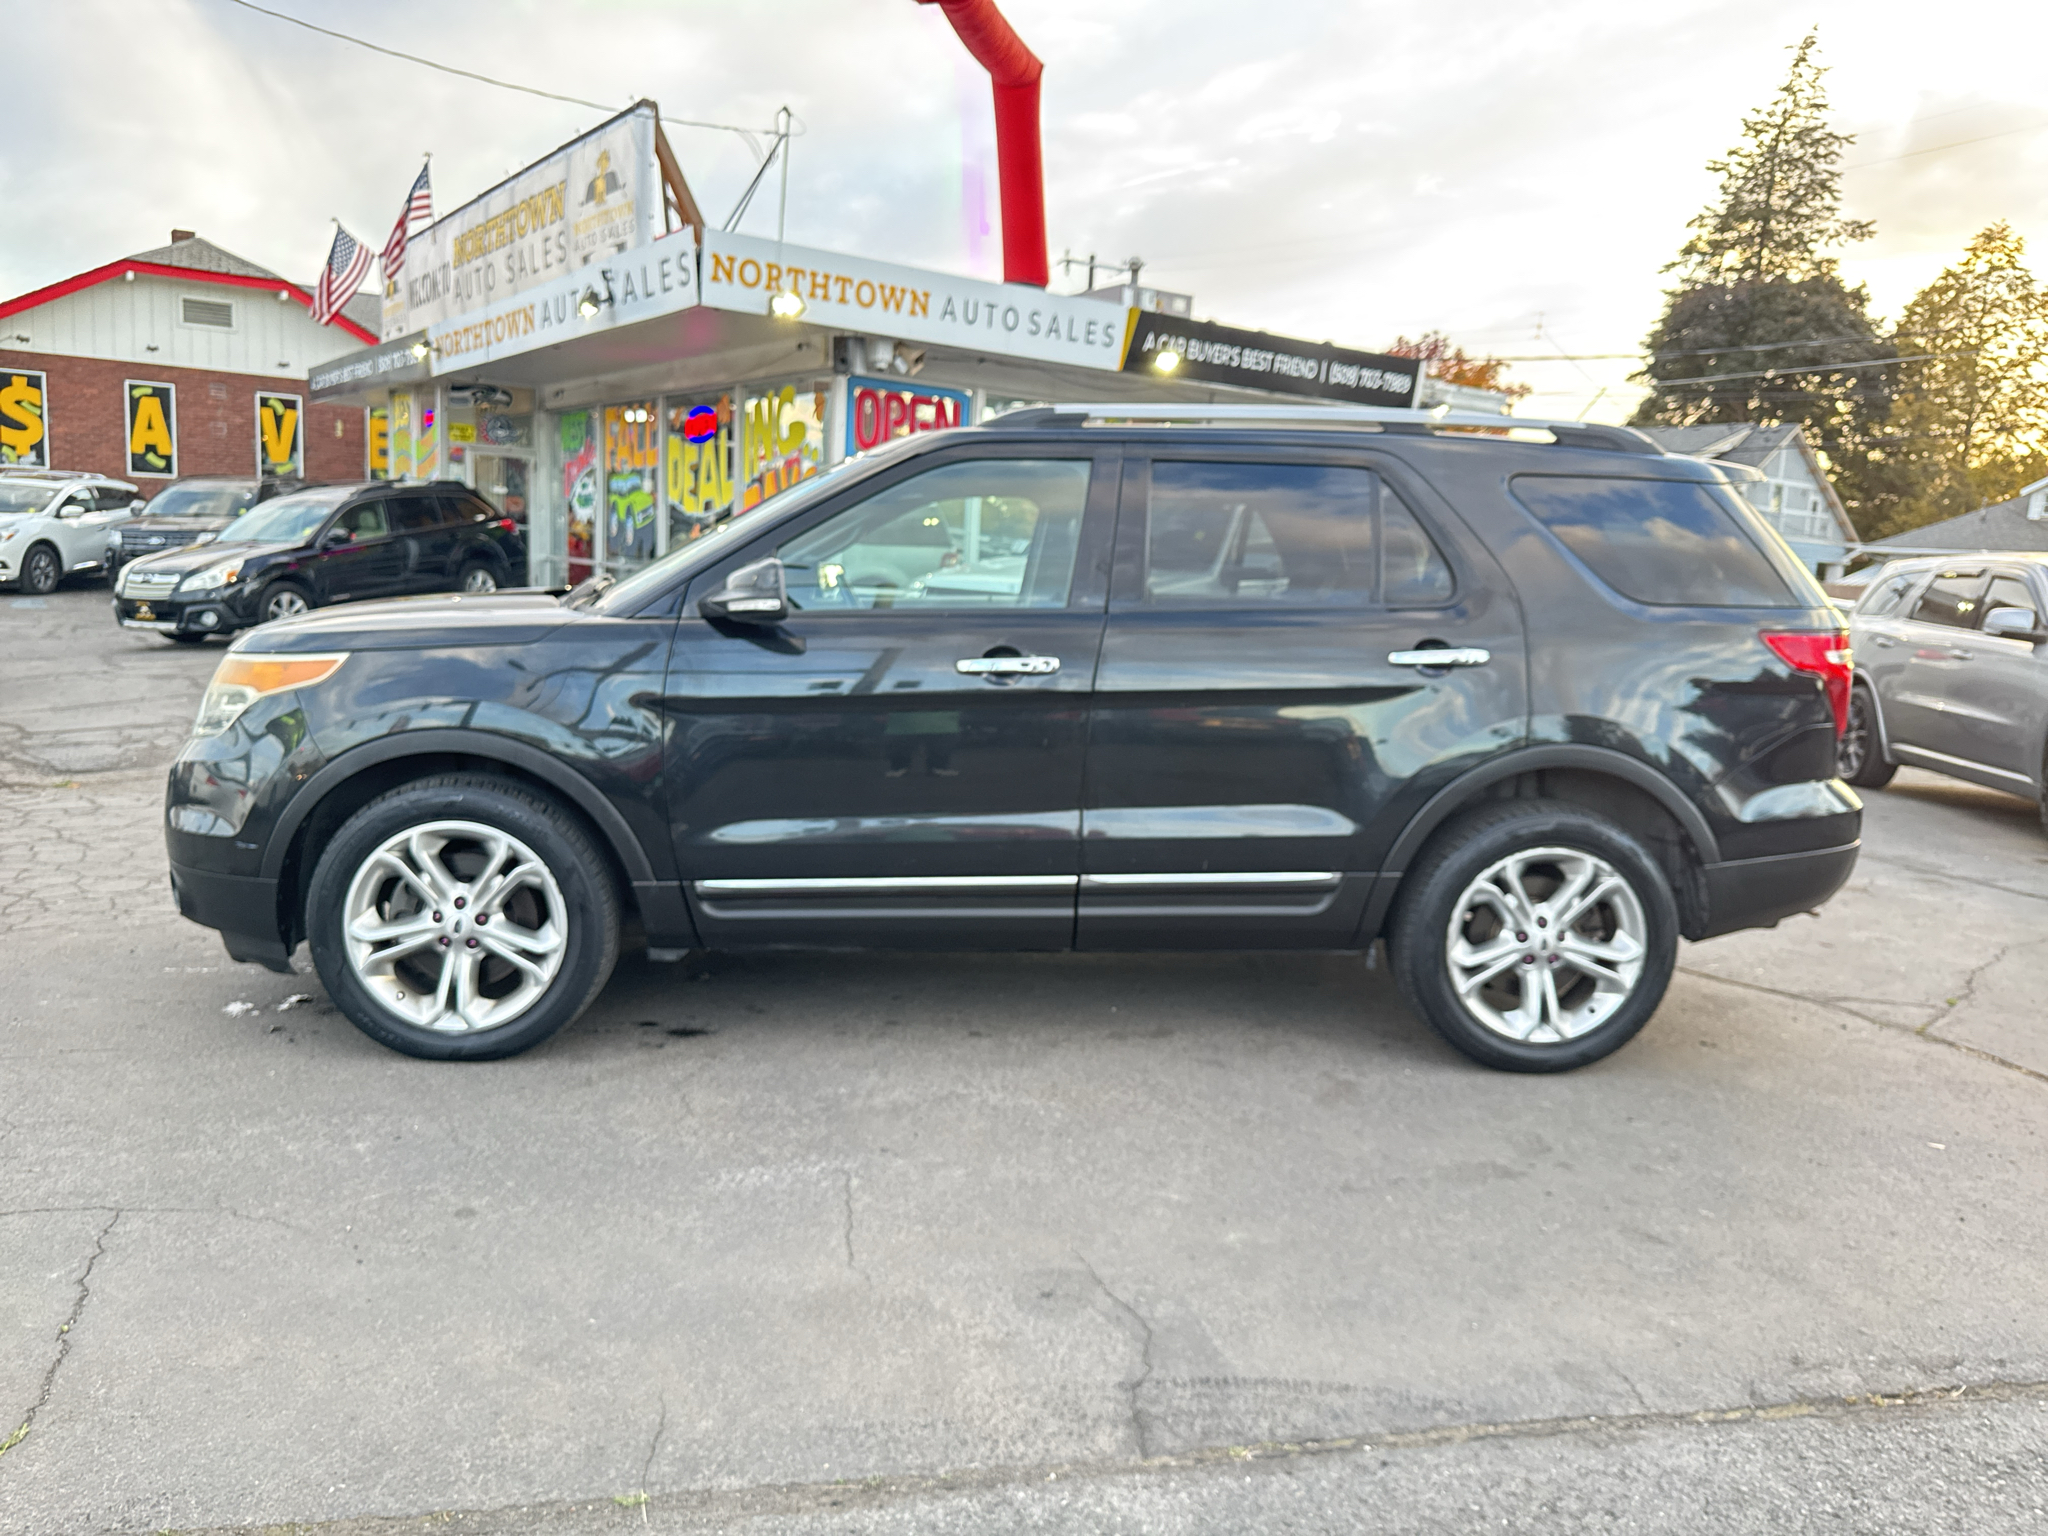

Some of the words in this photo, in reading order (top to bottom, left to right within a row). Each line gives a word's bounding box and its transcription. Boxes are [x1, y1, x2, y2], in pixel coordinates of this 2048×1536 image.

[453, 181, 567, 270] NORTHTOWN
[574, 231, 597, 251] AUTO
[599, 219, 635, 243] SALES
[454, 263, 497, 303] AUTO
[505, 231, 568, 285] SALES
[711, 252, 932, 318] NORTHTOWN
[940, 295, 1020, 333] AUTO
[1027, 312, 1116, 348] SALES
[434, 303, 536, 359] NORTHTOWN
[1142, 331, 1155, 352] A
[1240, 347, 1274, 372] BEST
[1272, 352, 1319, 379] FRIEND
[605, 402, 659, 471] FALL
[854, 388, 961, 451] OPEN
